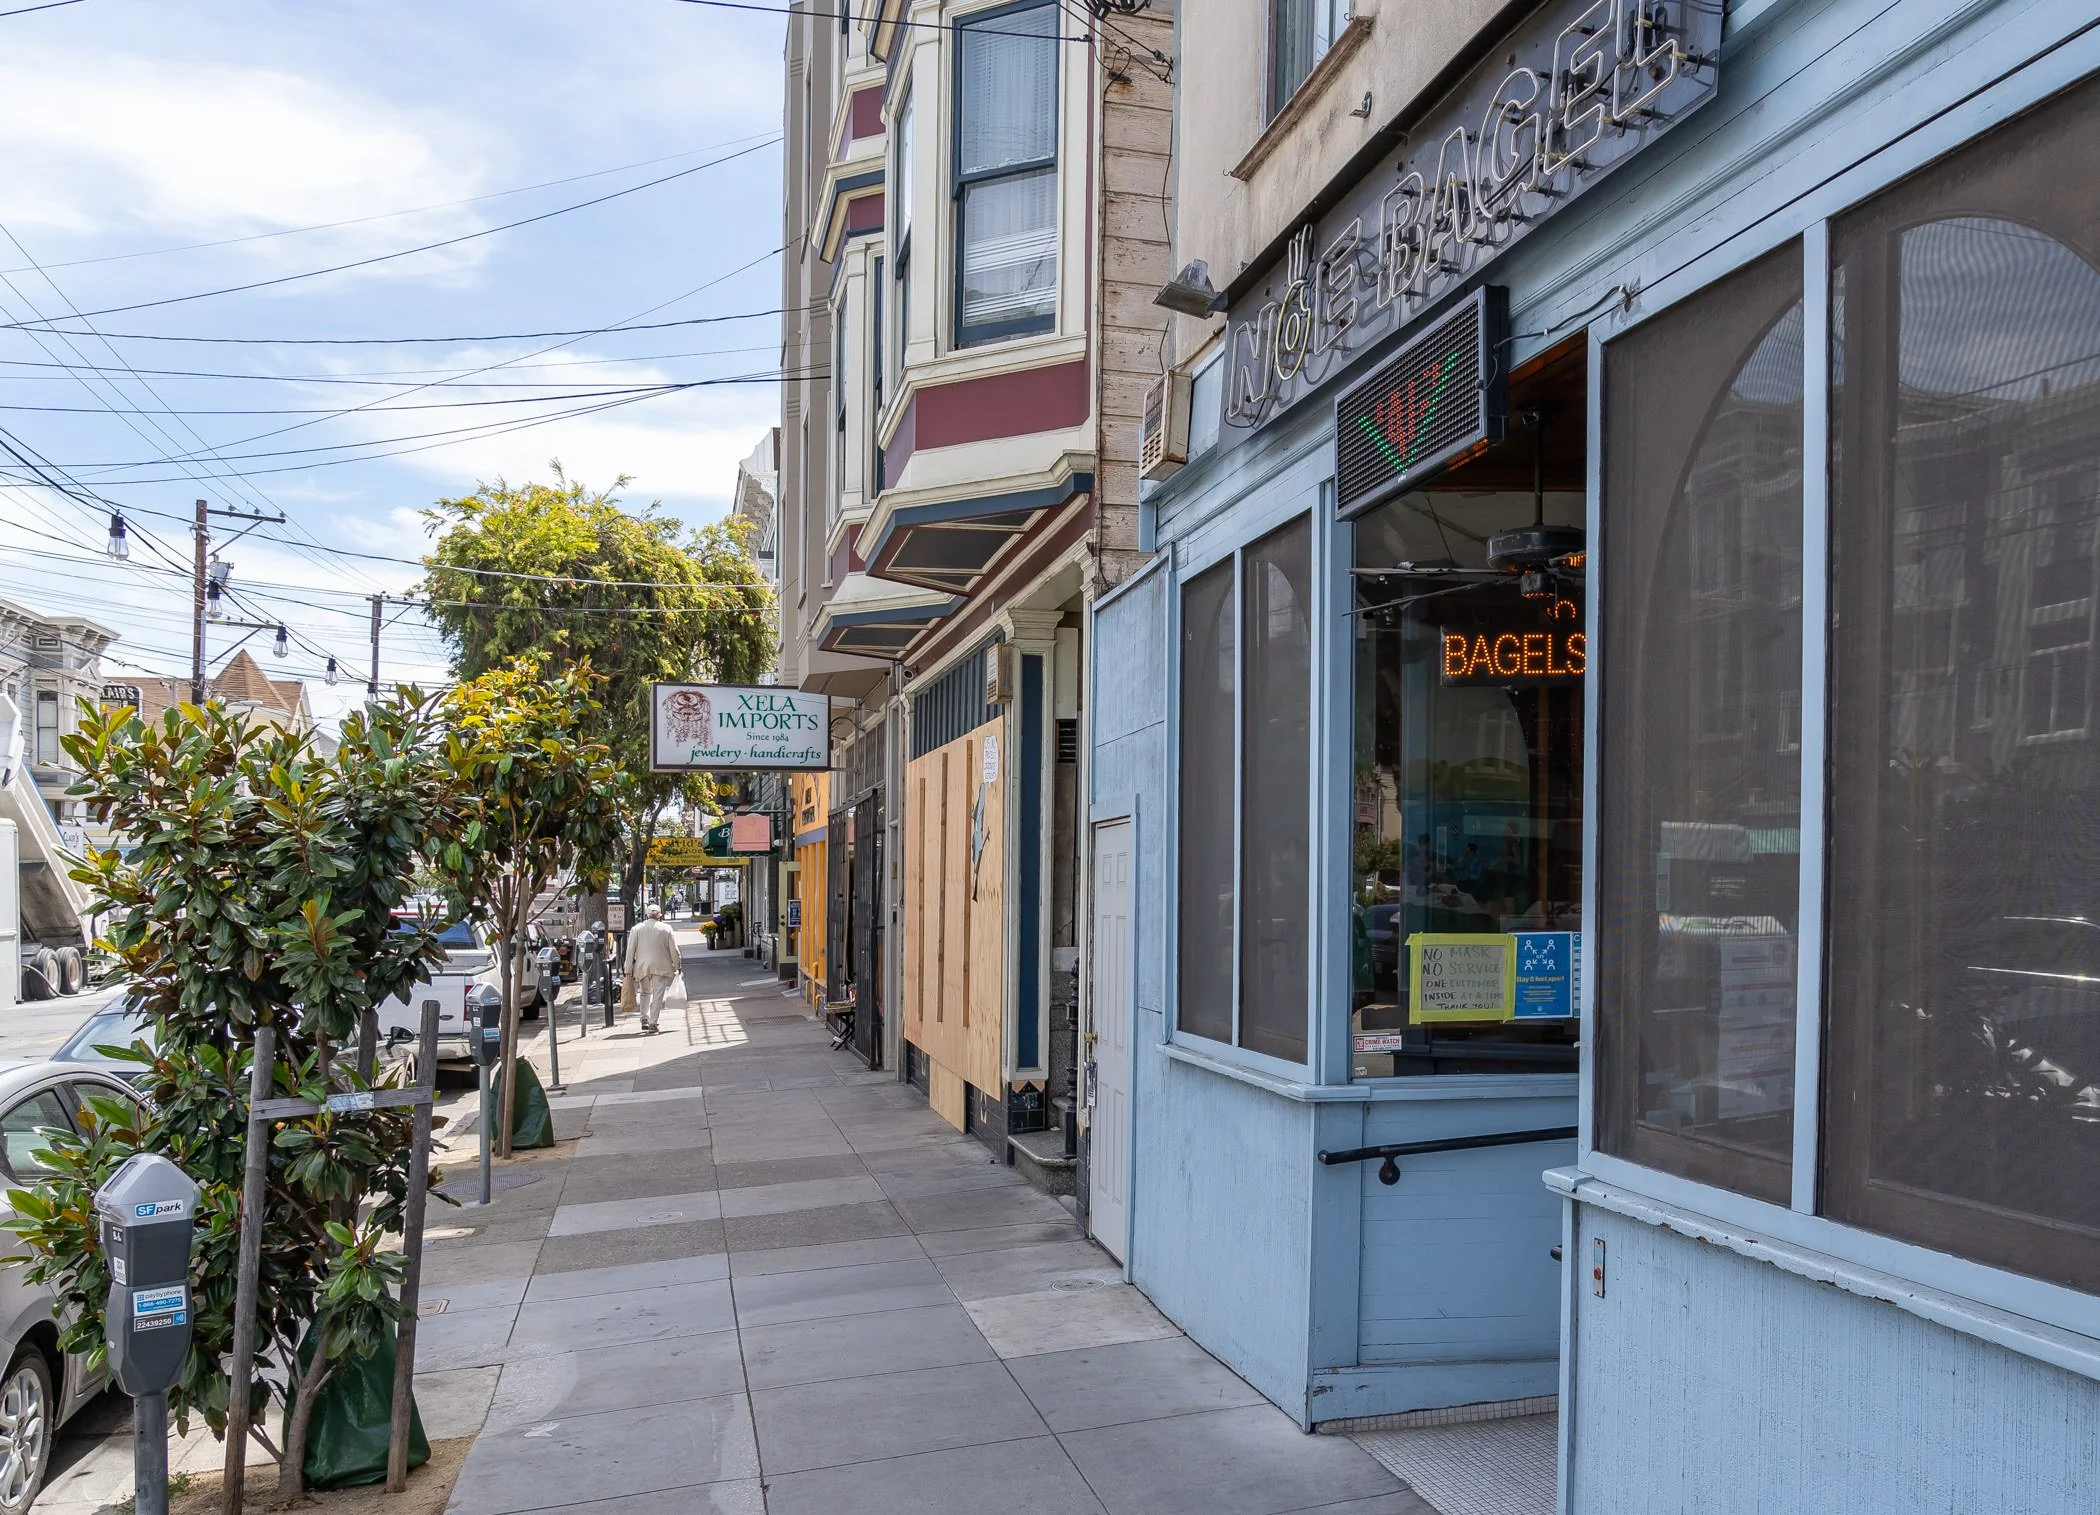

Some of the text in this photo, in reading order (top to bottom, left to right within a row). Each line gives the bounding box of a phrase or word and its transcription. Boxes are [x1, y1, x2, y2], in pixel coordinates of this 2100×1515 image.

[1377, 0, 1678, 308] BAGEL
[1446, 634, 1586, 674] BAGELS
[99, 686, 135, 699] LAIR'S
[737, 694, 797, 712] XELA
[717, 712, 819, 731] IMPORTS
[746, 731, 789, 742] Since 1984
[686, 744, 821, 764] jewelery handicrafts
[1423, 946, 1493, 961] NO MASK
[1422, 961, 1501, 976] NO SERVICE
[1426, 979, 1500, 988] ONE CUSTOMER
[1424, 991, 1504, 1001] INSIDE AT A TIME
[1472, 1002, 1495, 1010] YOU!
[138, 1202, 182, 1216] SFpark
[145, 1288, 182, 1300] paybyphone
[136, 1318, 172, 1329] 22439250
